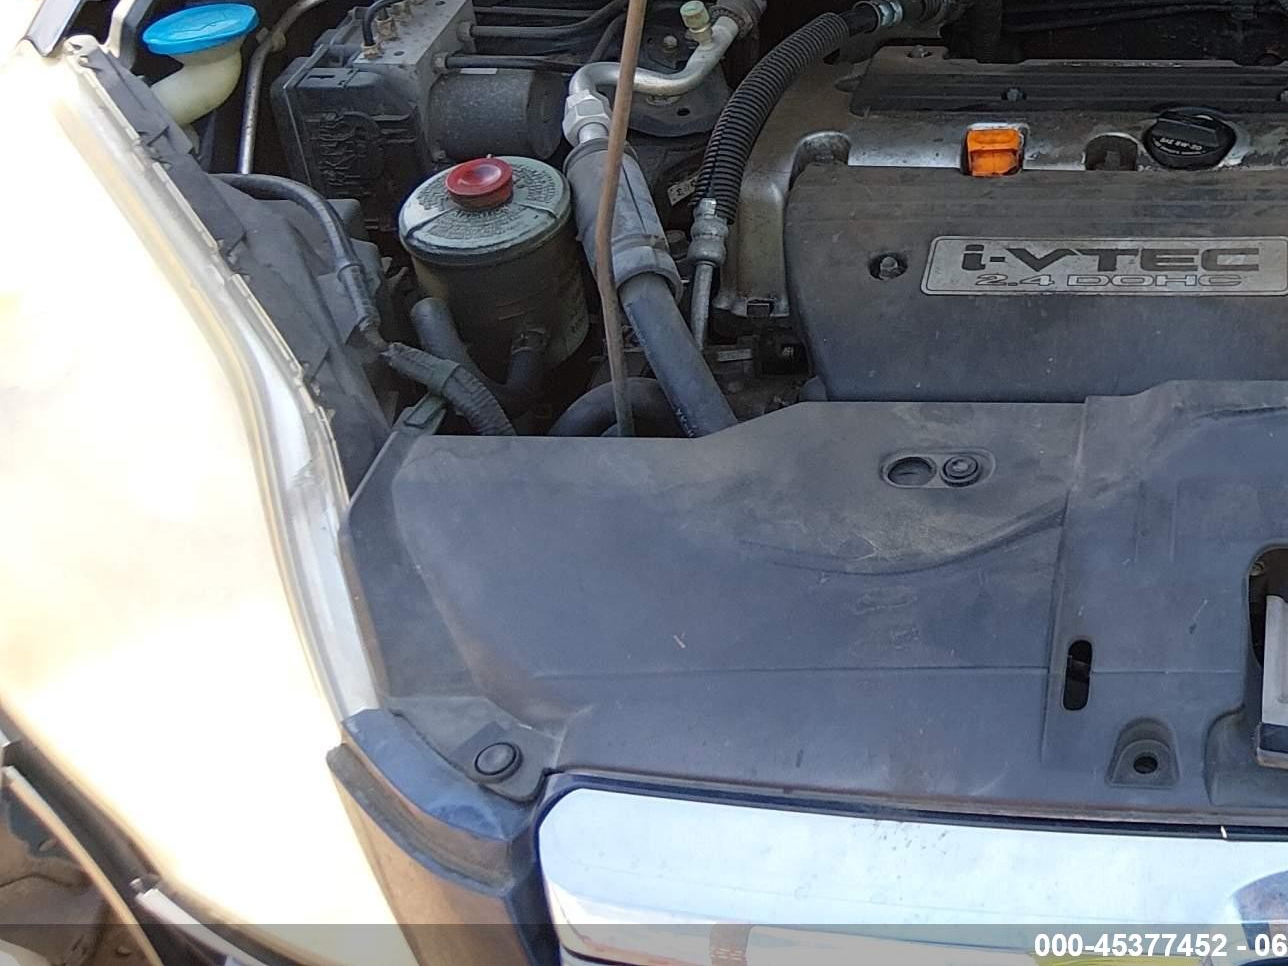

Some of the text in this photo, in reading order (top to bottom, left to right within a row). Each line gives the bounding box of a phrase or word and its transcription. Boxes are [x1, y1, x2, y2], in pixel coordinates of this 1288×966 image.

[961, 244, 1260, 273] i-VTEC
[975, 274, 1242, 287] 2.4 DOHC
